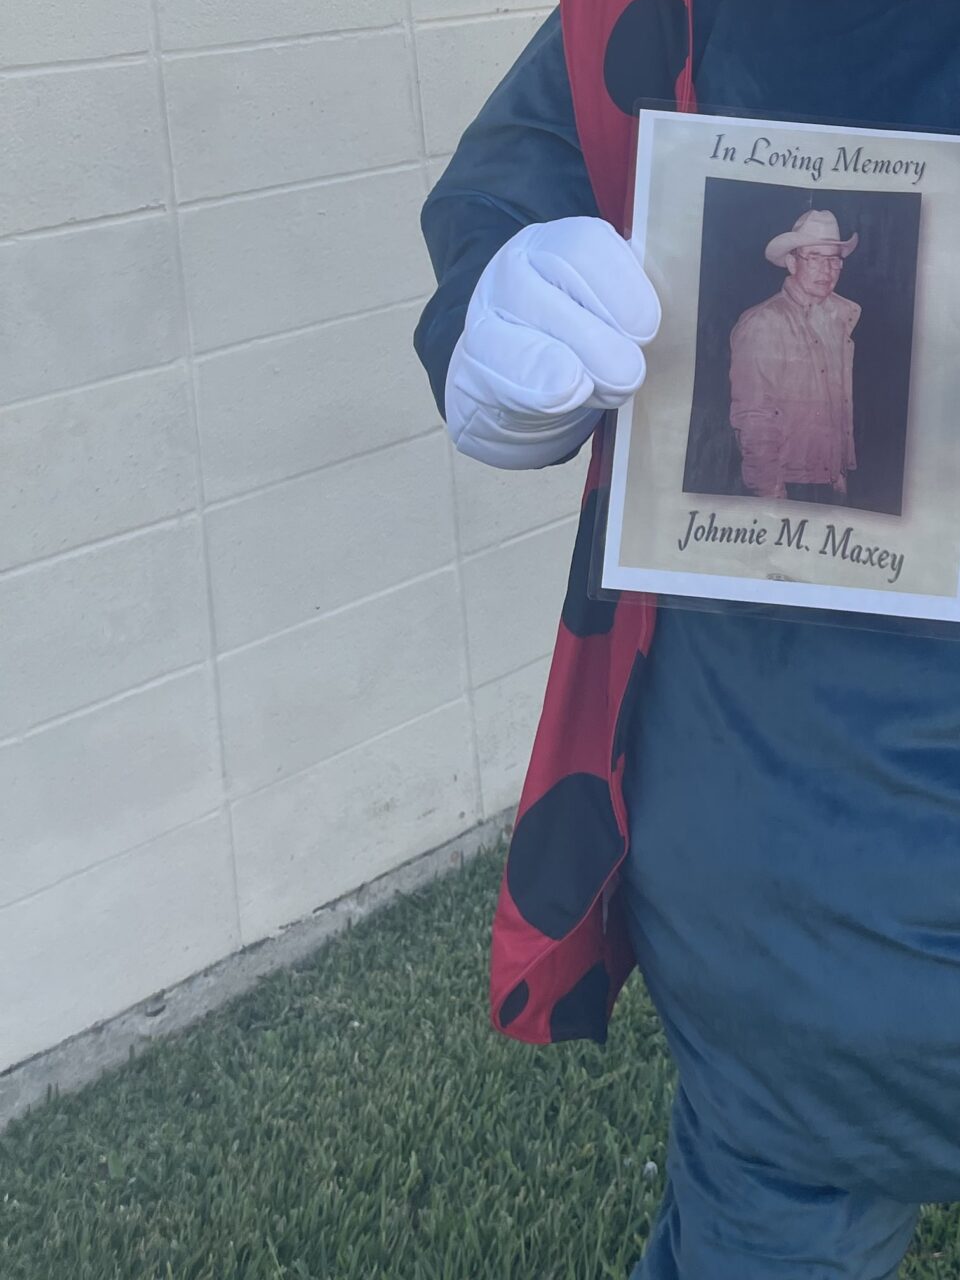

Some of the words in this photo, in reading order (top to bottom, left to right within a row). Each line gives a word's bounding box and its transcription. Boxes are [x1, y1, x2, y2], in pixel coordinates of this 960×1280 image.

[709, 133, 736, 162] In
[743, 137, 824, 182] Loving
[831, 146, 926, 185] Memory
[678, 510, 768, 551] Johnnie
[774, 518, 811, 552] M.
[818, 524, 905, 583] Maxey
